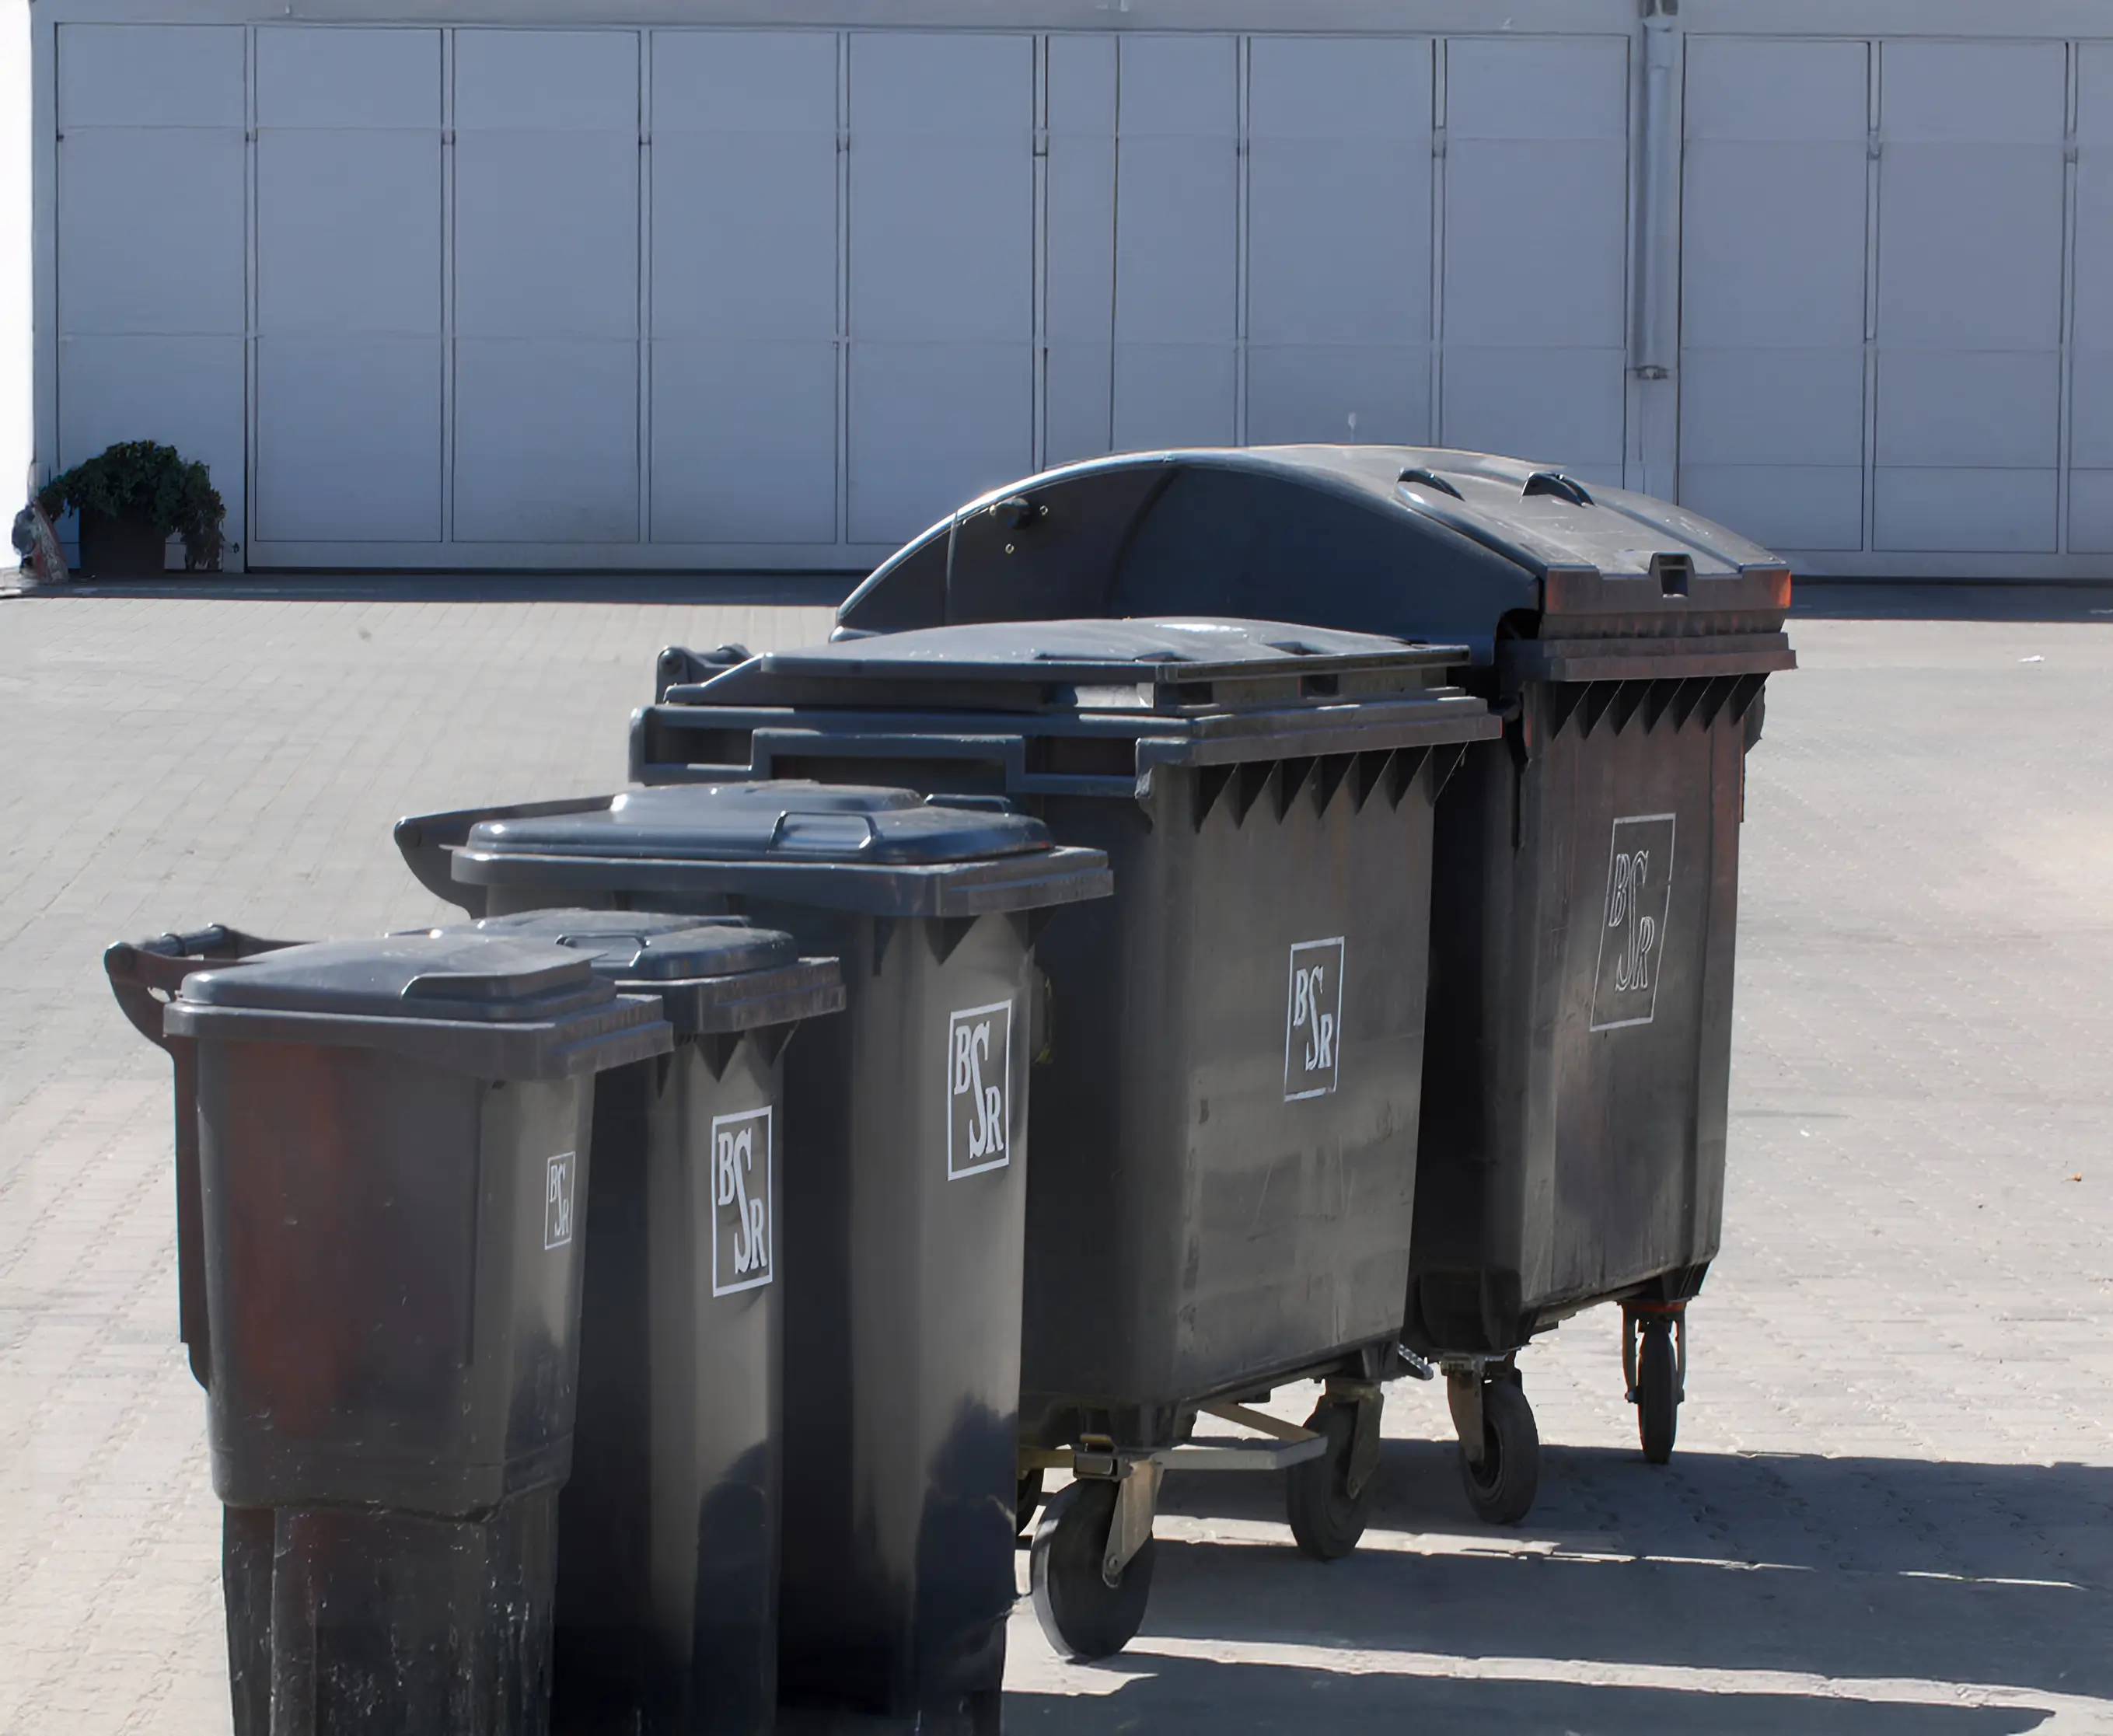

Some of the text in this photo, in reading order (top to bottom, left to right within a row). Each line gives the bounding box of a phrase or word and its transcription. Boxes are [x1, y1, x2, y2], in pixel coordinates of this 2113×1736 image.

[1293, 965, 1333, 1071] BSR
[953, 1020, 1004, 1160] BSR
[718, 1126, 768, 1275] BSR
